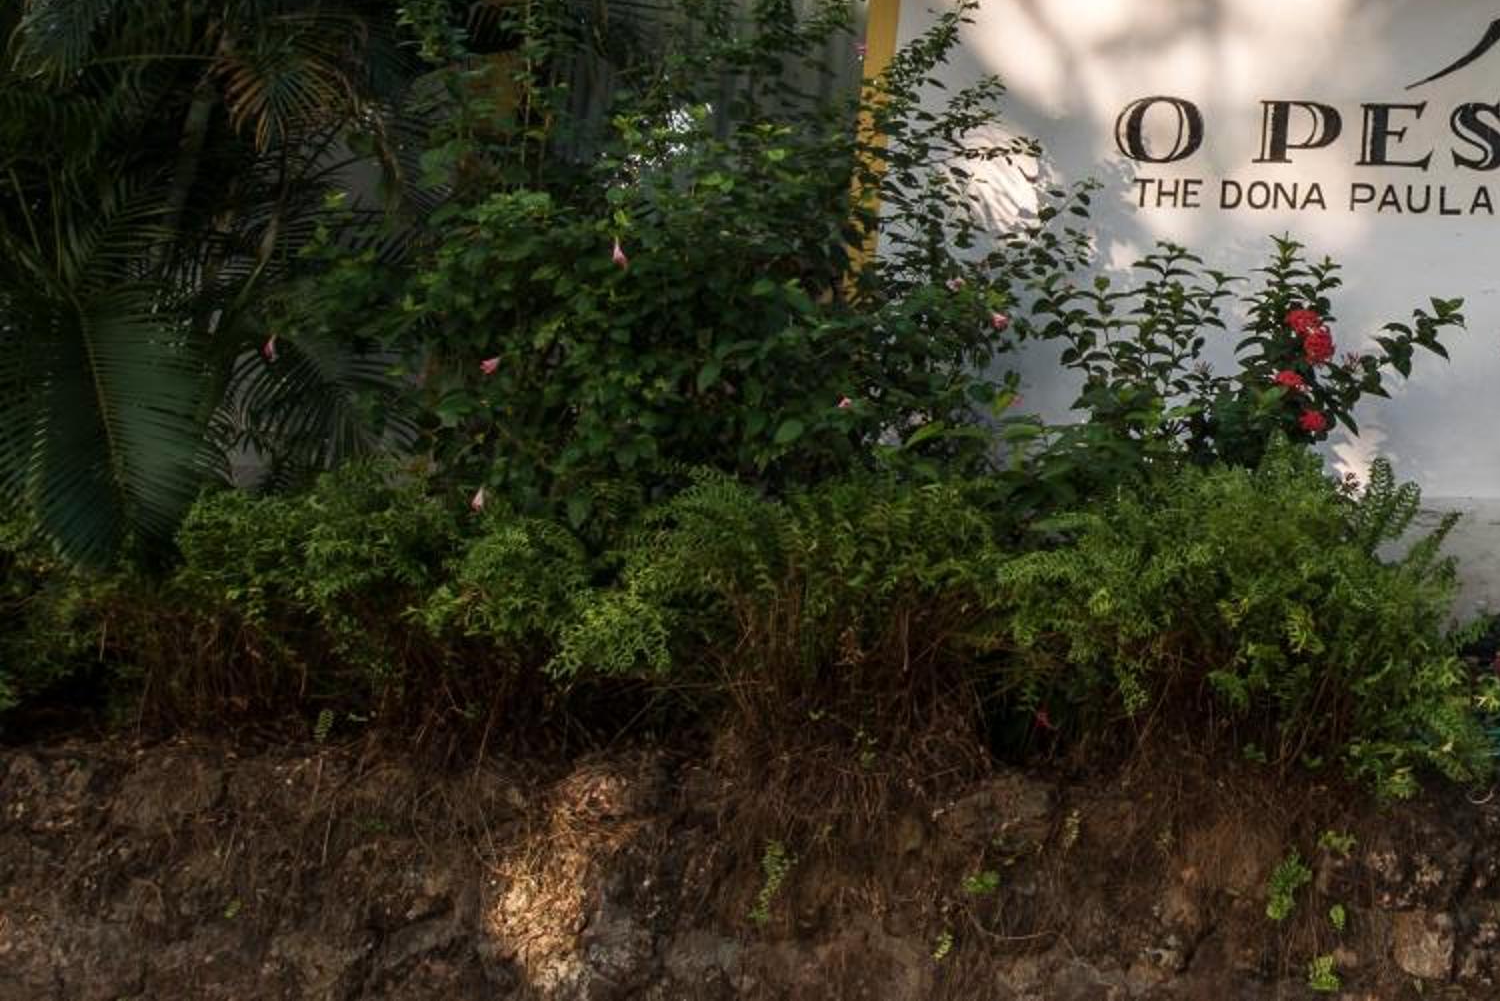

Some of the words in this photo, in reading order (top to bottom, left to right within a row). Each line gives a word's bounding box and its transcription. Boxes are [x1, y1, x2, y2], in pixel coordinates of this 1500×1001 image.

[1115, 96, 1204, 163] O
[1133, 178, 1203, 209] THE
[1219, 181, 1326, 210] DONA
[1350, 184, 1494, 216] PAULA
